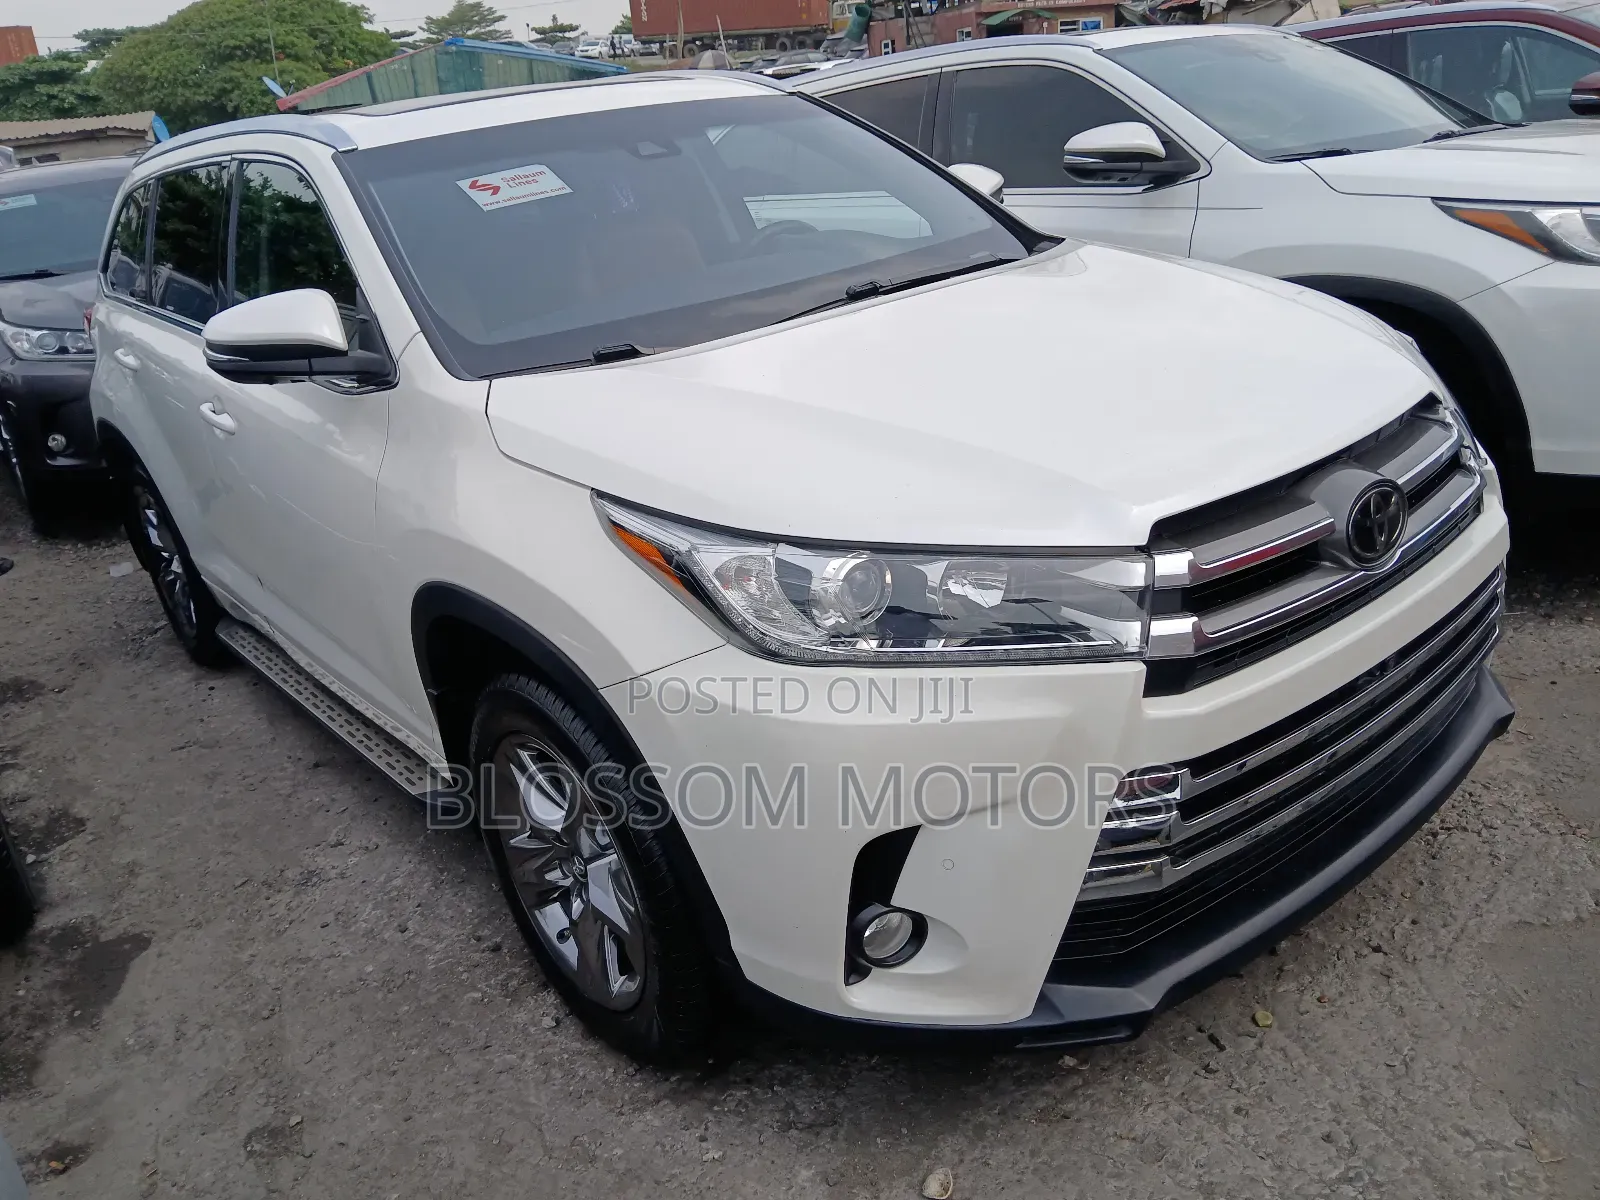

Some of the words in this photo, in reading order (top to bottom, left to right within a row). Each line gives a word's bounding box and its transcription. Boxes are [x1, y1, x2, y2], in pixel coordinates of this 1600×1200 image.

[501, 170, 547, 183] Sallaum
[506, 178, 539, 189] Lines
[481, 186, 567, 207] www.sallaumlines.com
